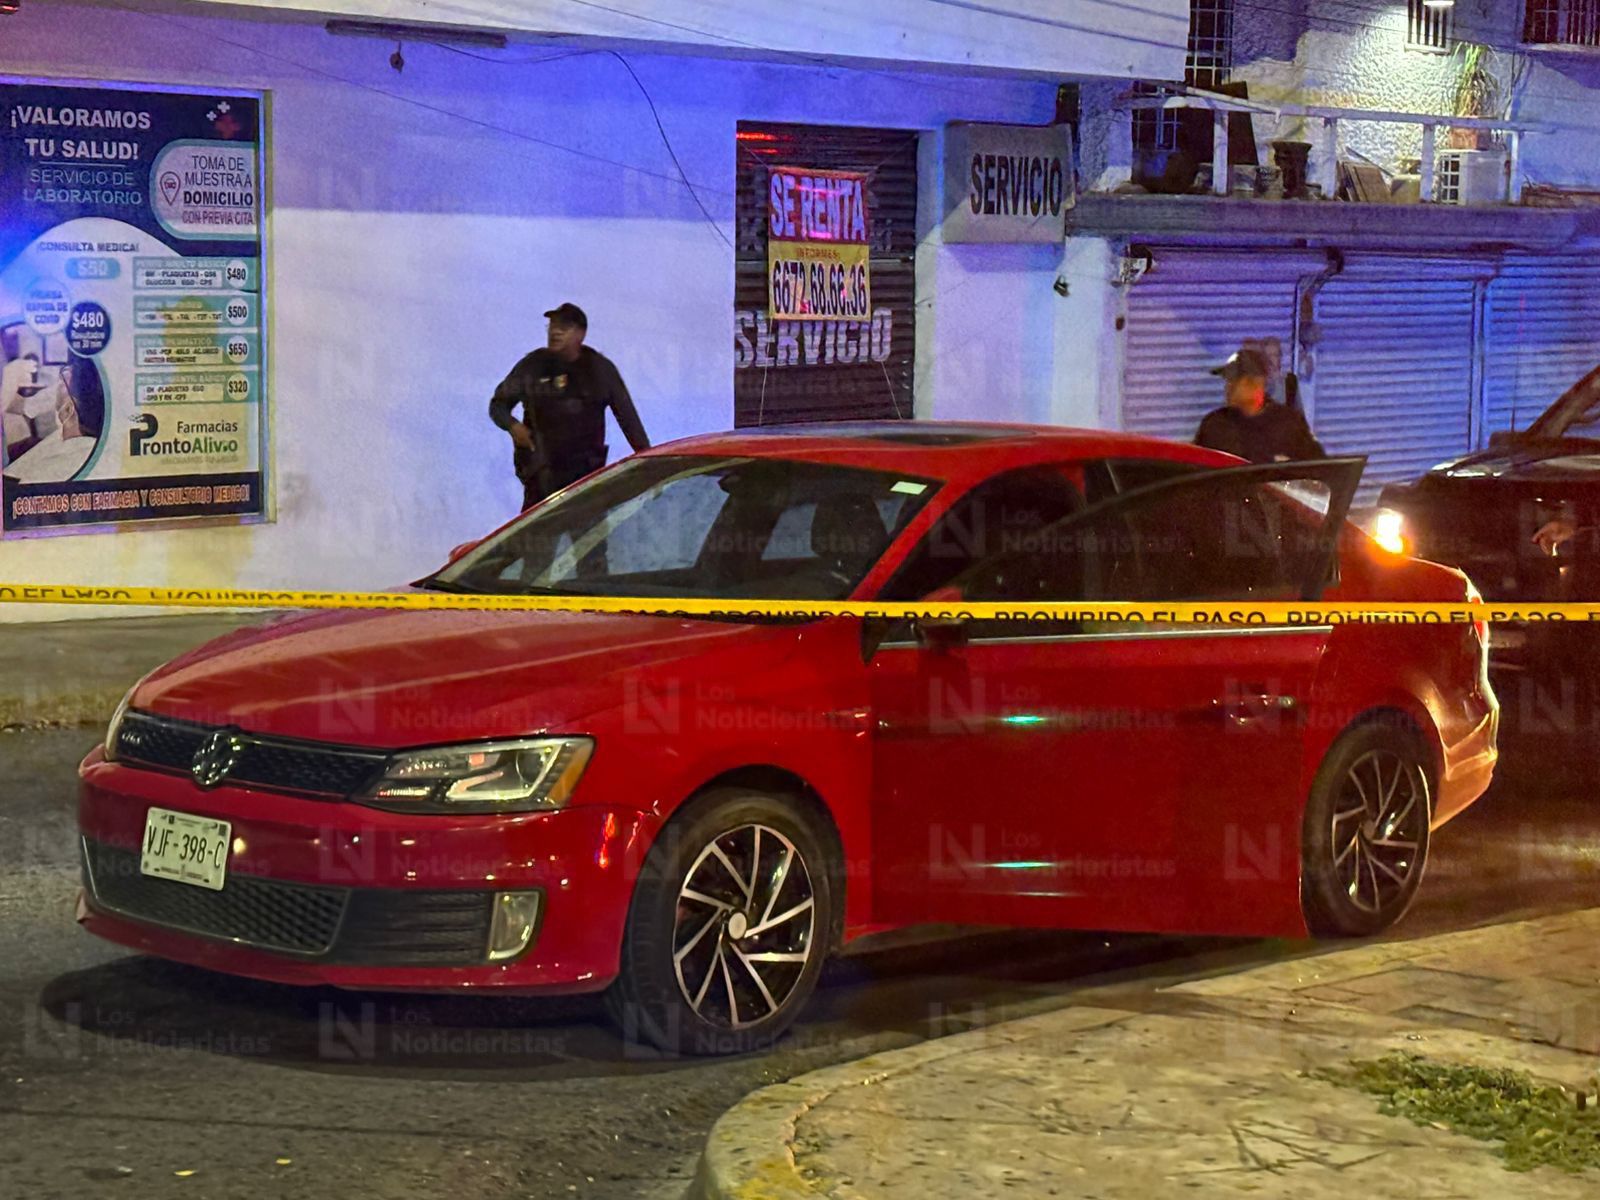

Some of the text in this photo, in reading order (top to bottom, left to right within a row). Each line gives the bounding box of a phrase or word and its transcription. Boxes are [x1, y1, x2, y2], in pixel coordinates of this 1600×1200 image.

[11, 105, 151, 129] ¡VALORAMOS
[25, 138, 139, 160] TU SALUD!
[192, 155, 244, 171] TOMA DE
[30, 168, 135, 186] SERVICIO DE
[185, 172, 253, 188] MUESTRA A
[970, 153, 1063, 217] SERVICIO
[23, 188, 142, 205] LABORATORIO
[183, 191, 253, 206] DOMICILIO
[771, 173, 796, 237] SE
[801, 177, 866, 241] RENTA
[227, 268, 247, 281] $480
[72, 311, 105, 329] $480
[228, 306, 248, 319] $500
[735, 308, 893, 368] SERVICIO
[229, 343, 248, 356] $650
[229, 380, 248, 394] $320
[177, 420, 239, 434] Farmacias
[71, 492, 92, 512] CON
[93, 489, 140, 510] FARMACIA
[147, 825, 225, 869] VJF-398-C
